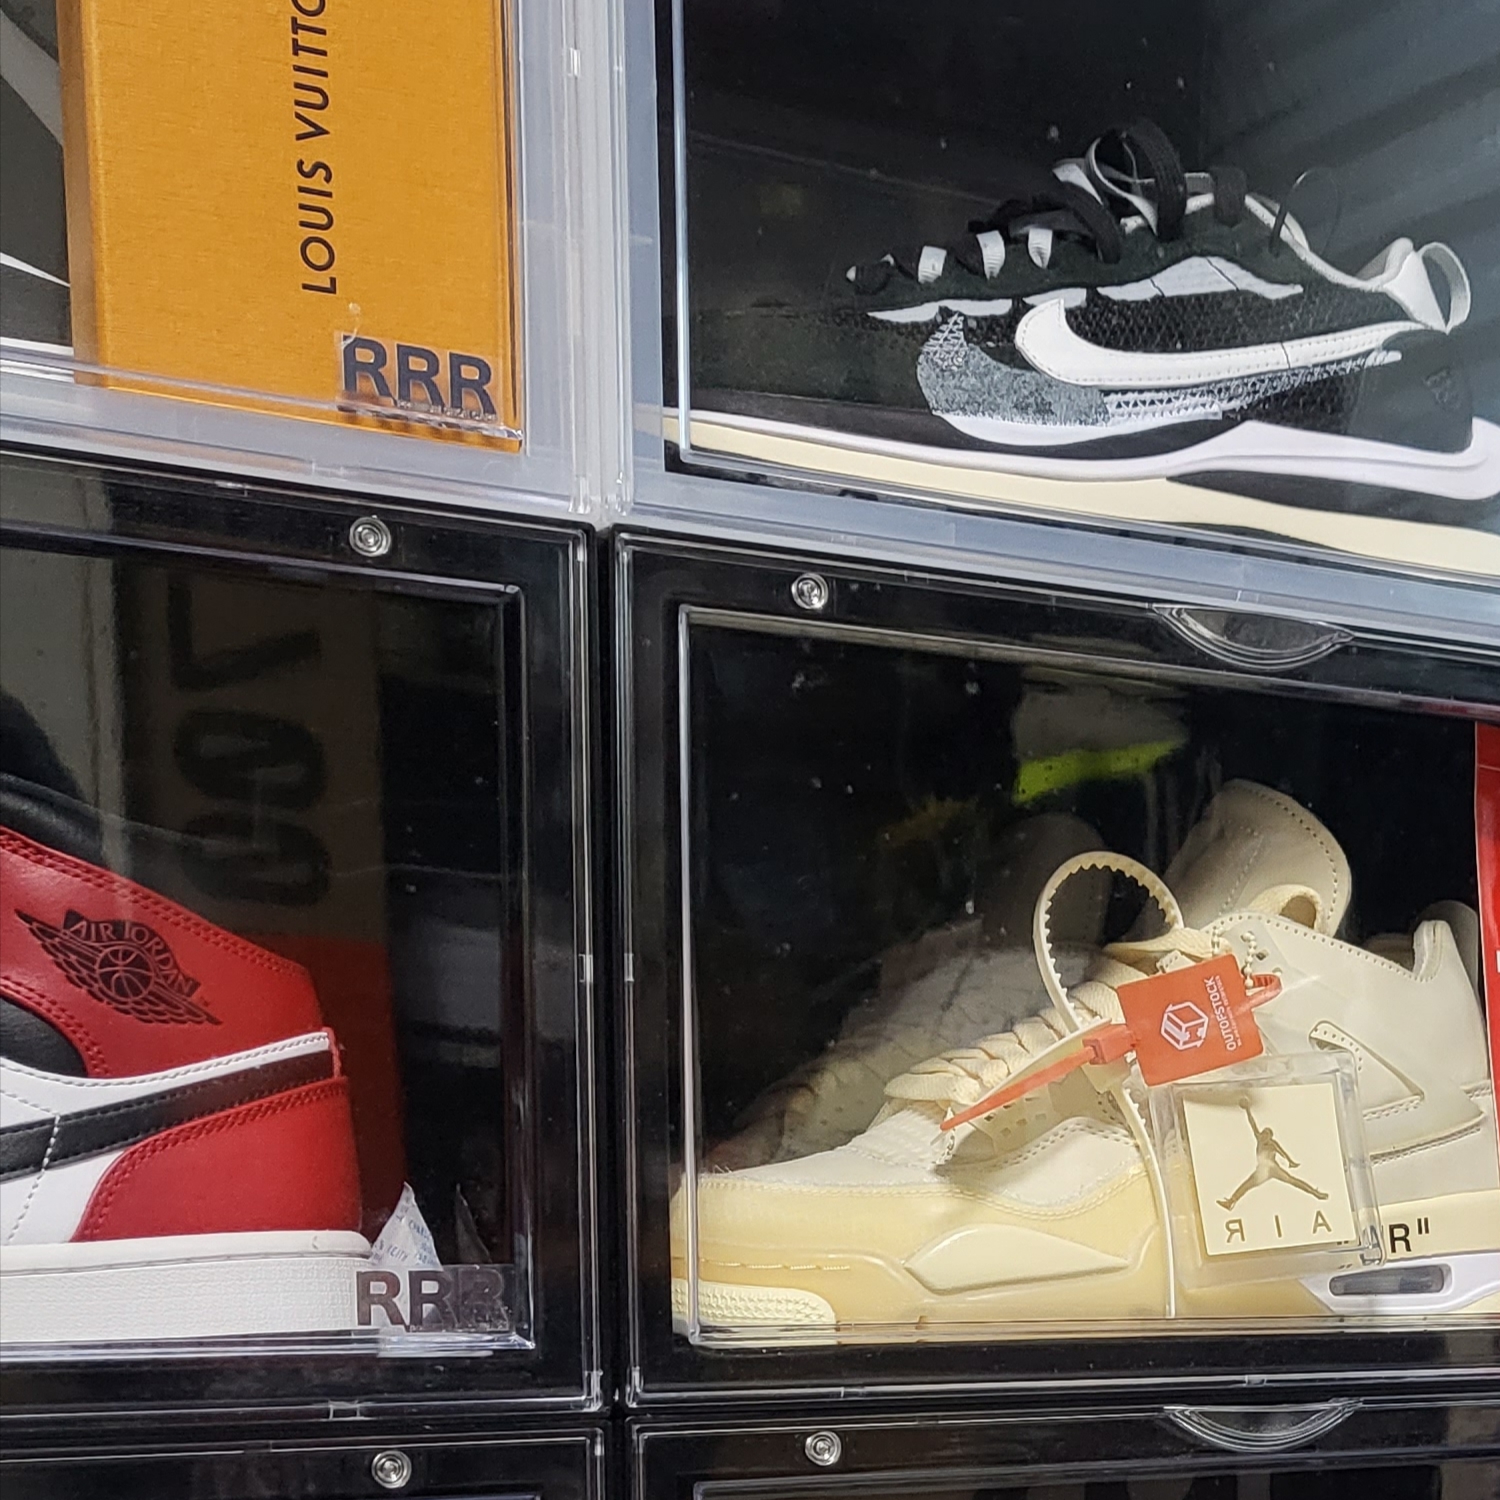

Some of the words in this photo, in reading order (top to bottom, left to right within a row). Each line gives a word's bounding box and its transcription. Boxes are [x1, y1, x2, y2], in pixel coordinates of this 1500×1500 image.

[301, 158, 337, 295] LOUIS
[342, 333, 498, 419] RRR
[69, 920, 117, 942] AIR
[1203, 975, 1237, 1052] OUTOFSTOCK
[356, 1269, 510, 1333] RRR
